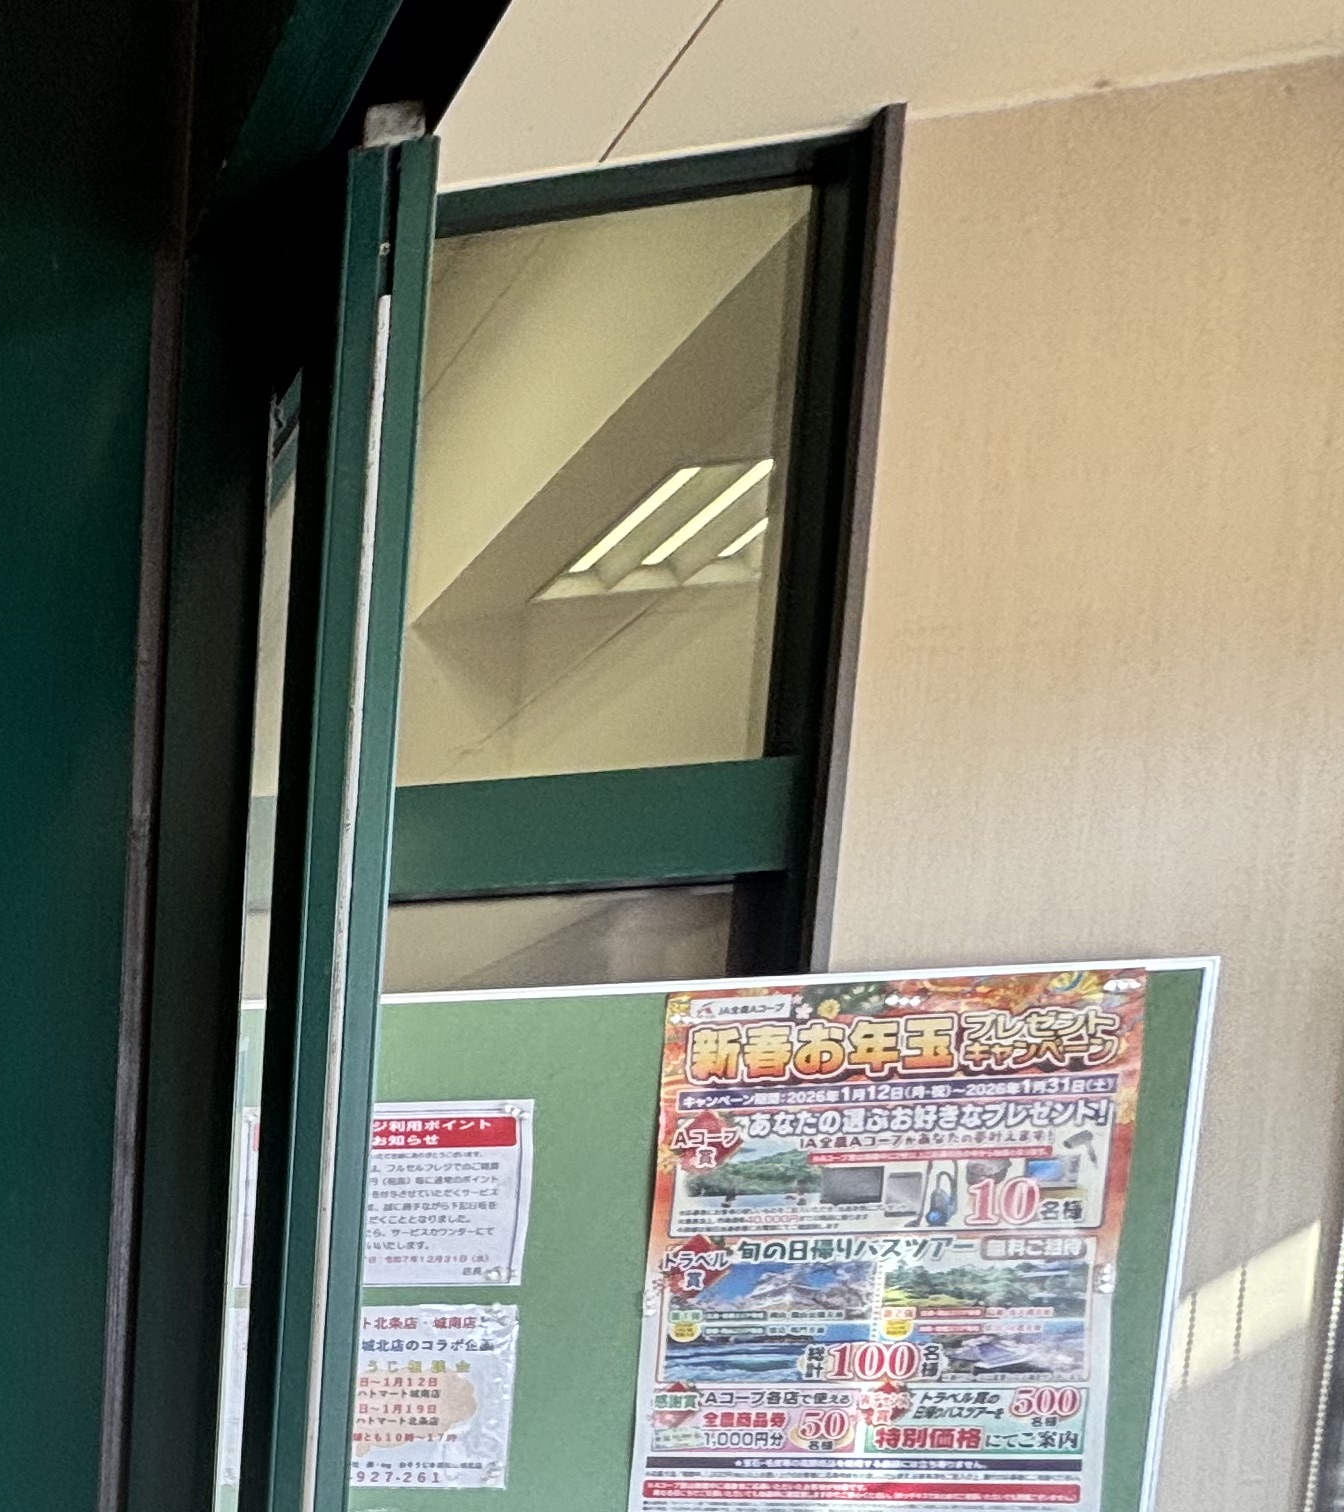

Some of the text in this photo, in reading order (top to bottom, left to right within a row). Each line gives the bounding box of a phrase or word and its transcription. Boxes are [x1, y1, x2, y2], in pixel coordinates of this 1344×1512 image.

[964, 1009, 1117, 1040] プレゼント
[690, 1016, 957, 1080] 新春お年玉
[963, 1037, 1117, 1068] キャンペーン
[372, 1134, 439, 1146] お知らせ
[674, 1129, 740, 1147] Aコープ
[664, 1251, 729, 1270] トラベル
[737, 1236, 976, 1261] 旬の日帰りバスツアー
[827, 1342, 920, 1380] 100
[1011, 1386, 1081, 1417] 500
[797, 1409, 850, 1440] 50
